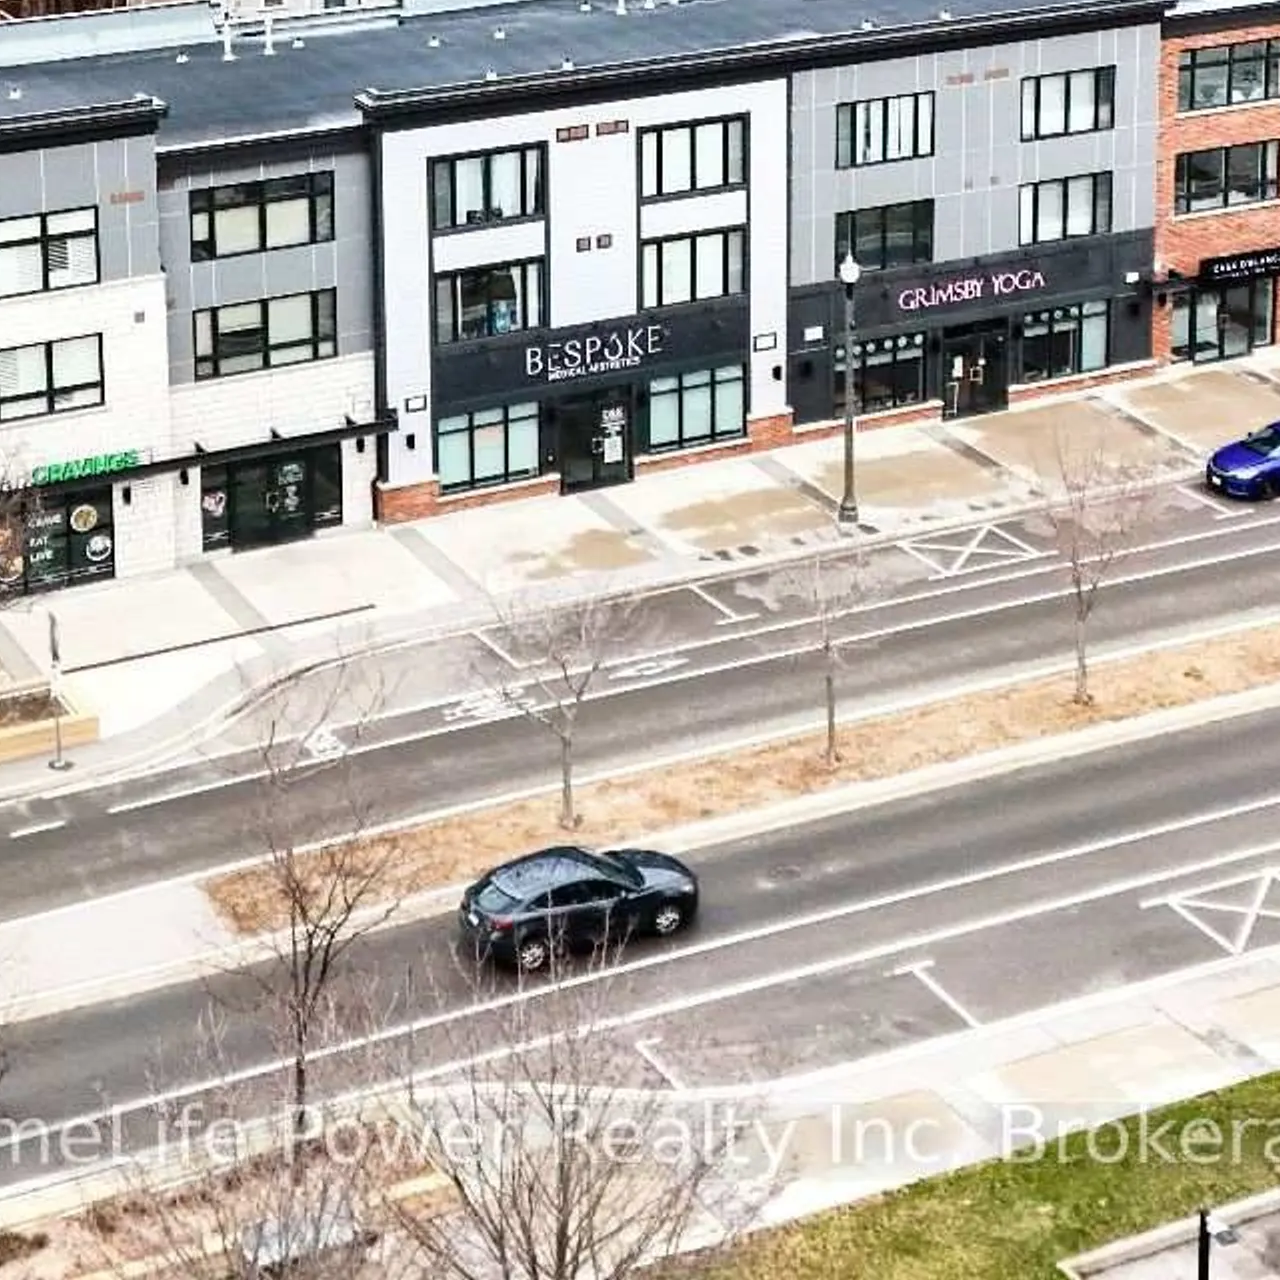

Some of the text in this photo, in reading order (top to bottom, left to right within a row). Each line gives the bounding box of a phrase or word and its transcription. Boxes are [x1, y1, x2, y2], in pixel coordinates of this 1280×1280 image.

[898, 270, 1046, 310] GRIMSBY YOGA
[525, 325, 663, 376] BESPOKE
[31, 448, 139, 486] CRAVINGS
